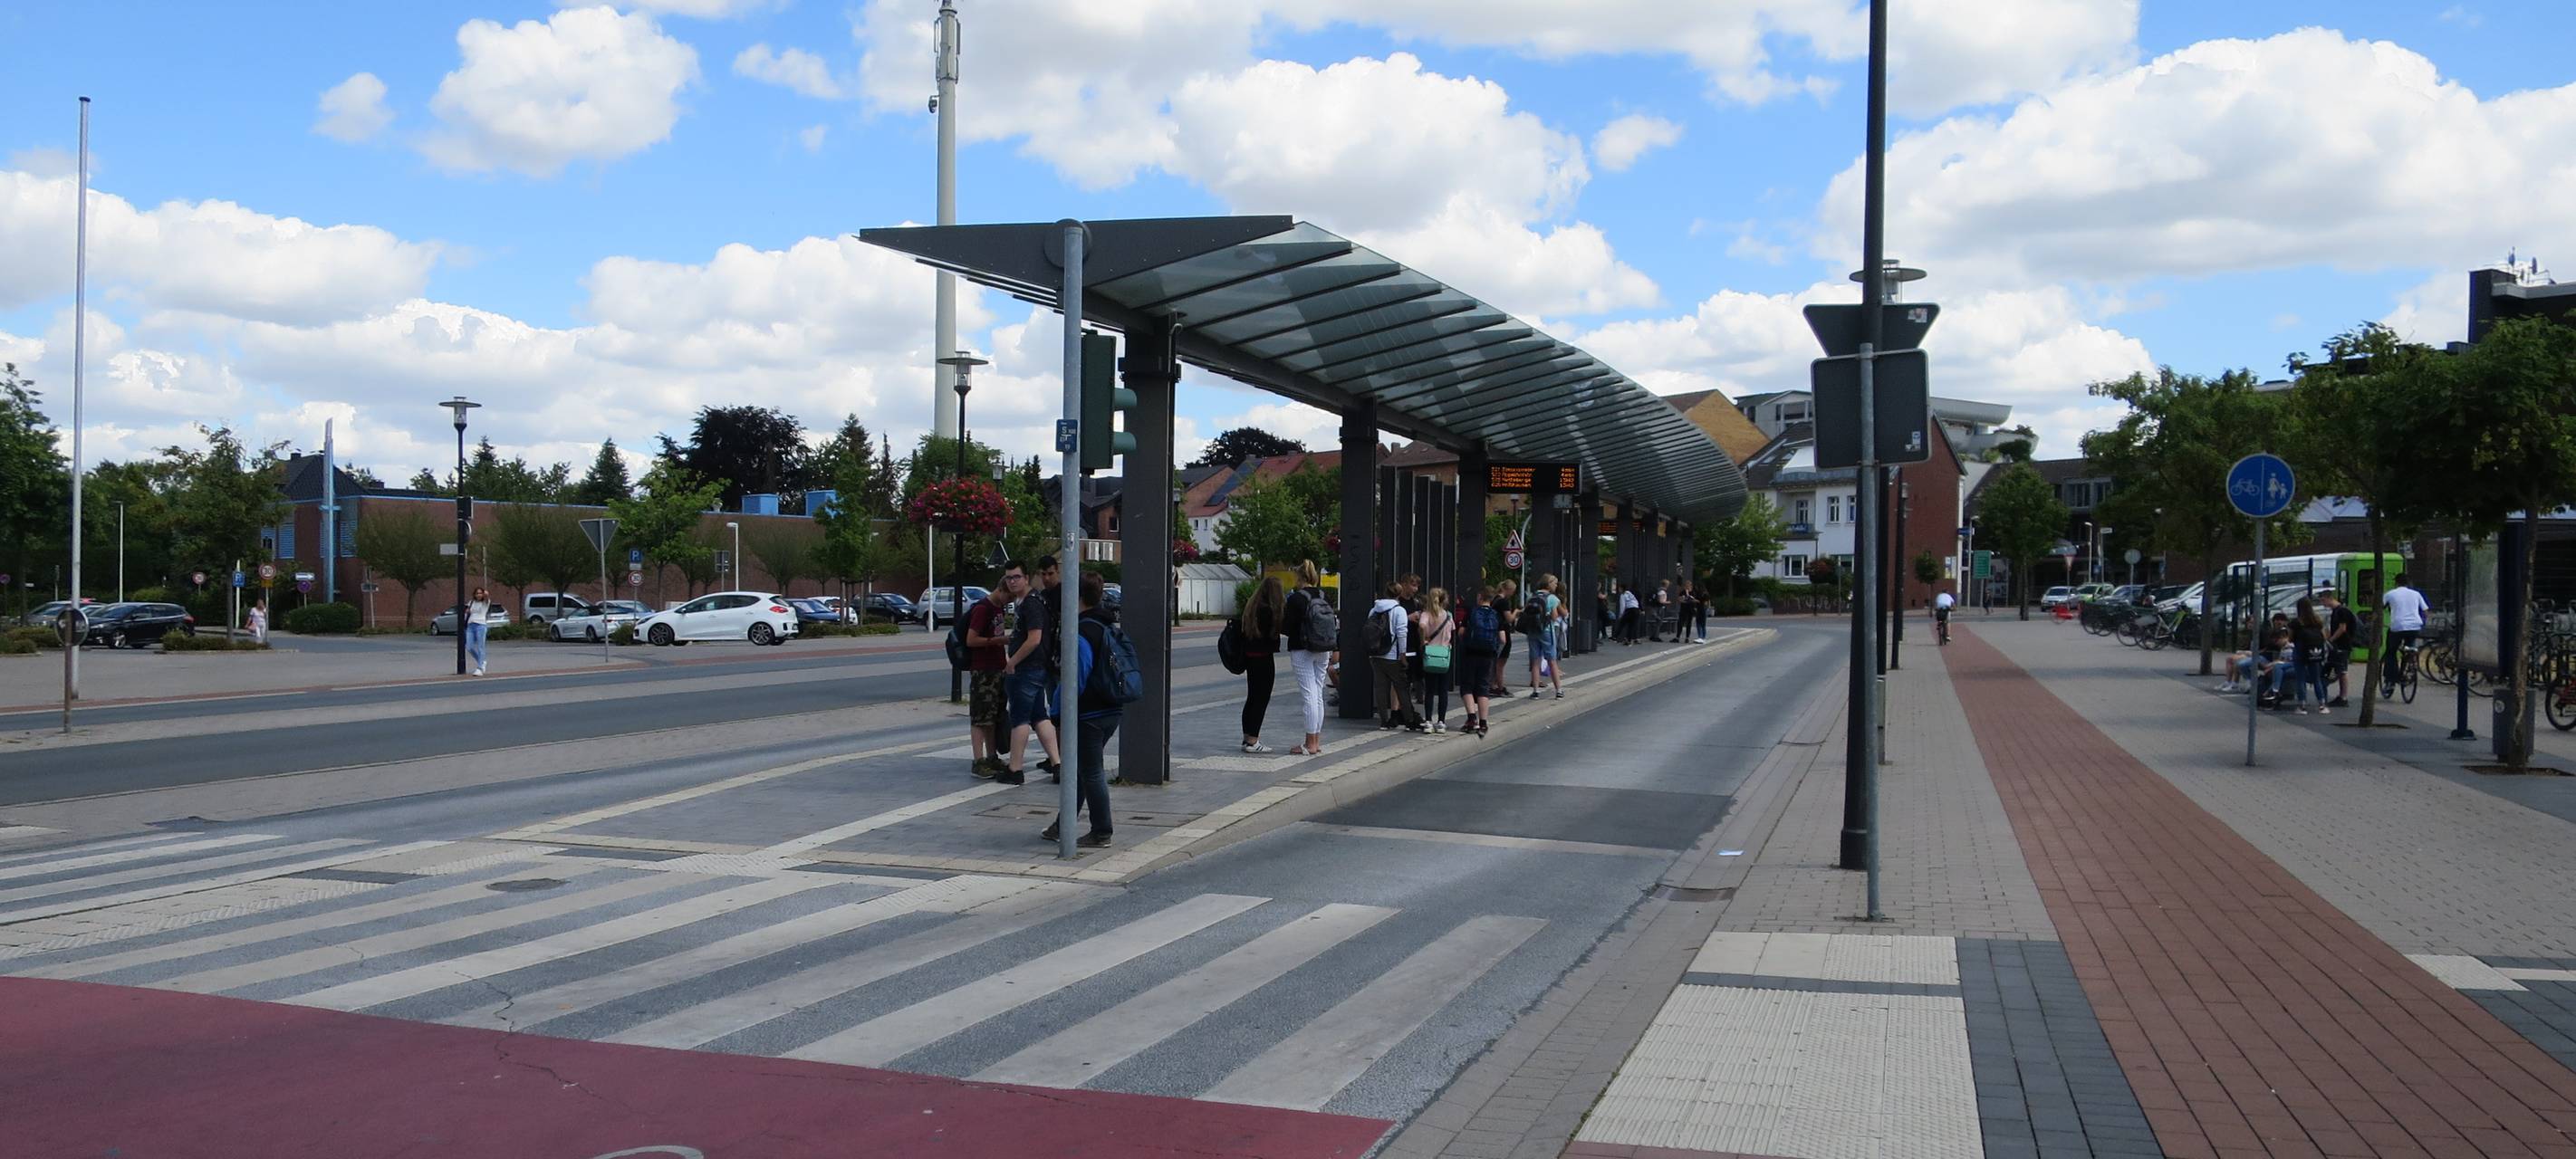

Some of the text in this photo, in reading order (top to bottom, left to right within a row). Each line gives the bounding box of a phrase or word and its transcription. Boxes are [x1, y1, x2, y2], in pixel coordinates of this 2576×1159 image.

[632, 551, 639, 560] P
[1509, 556, 1518, 564] 30
[264, 567, 272, 575] 30
